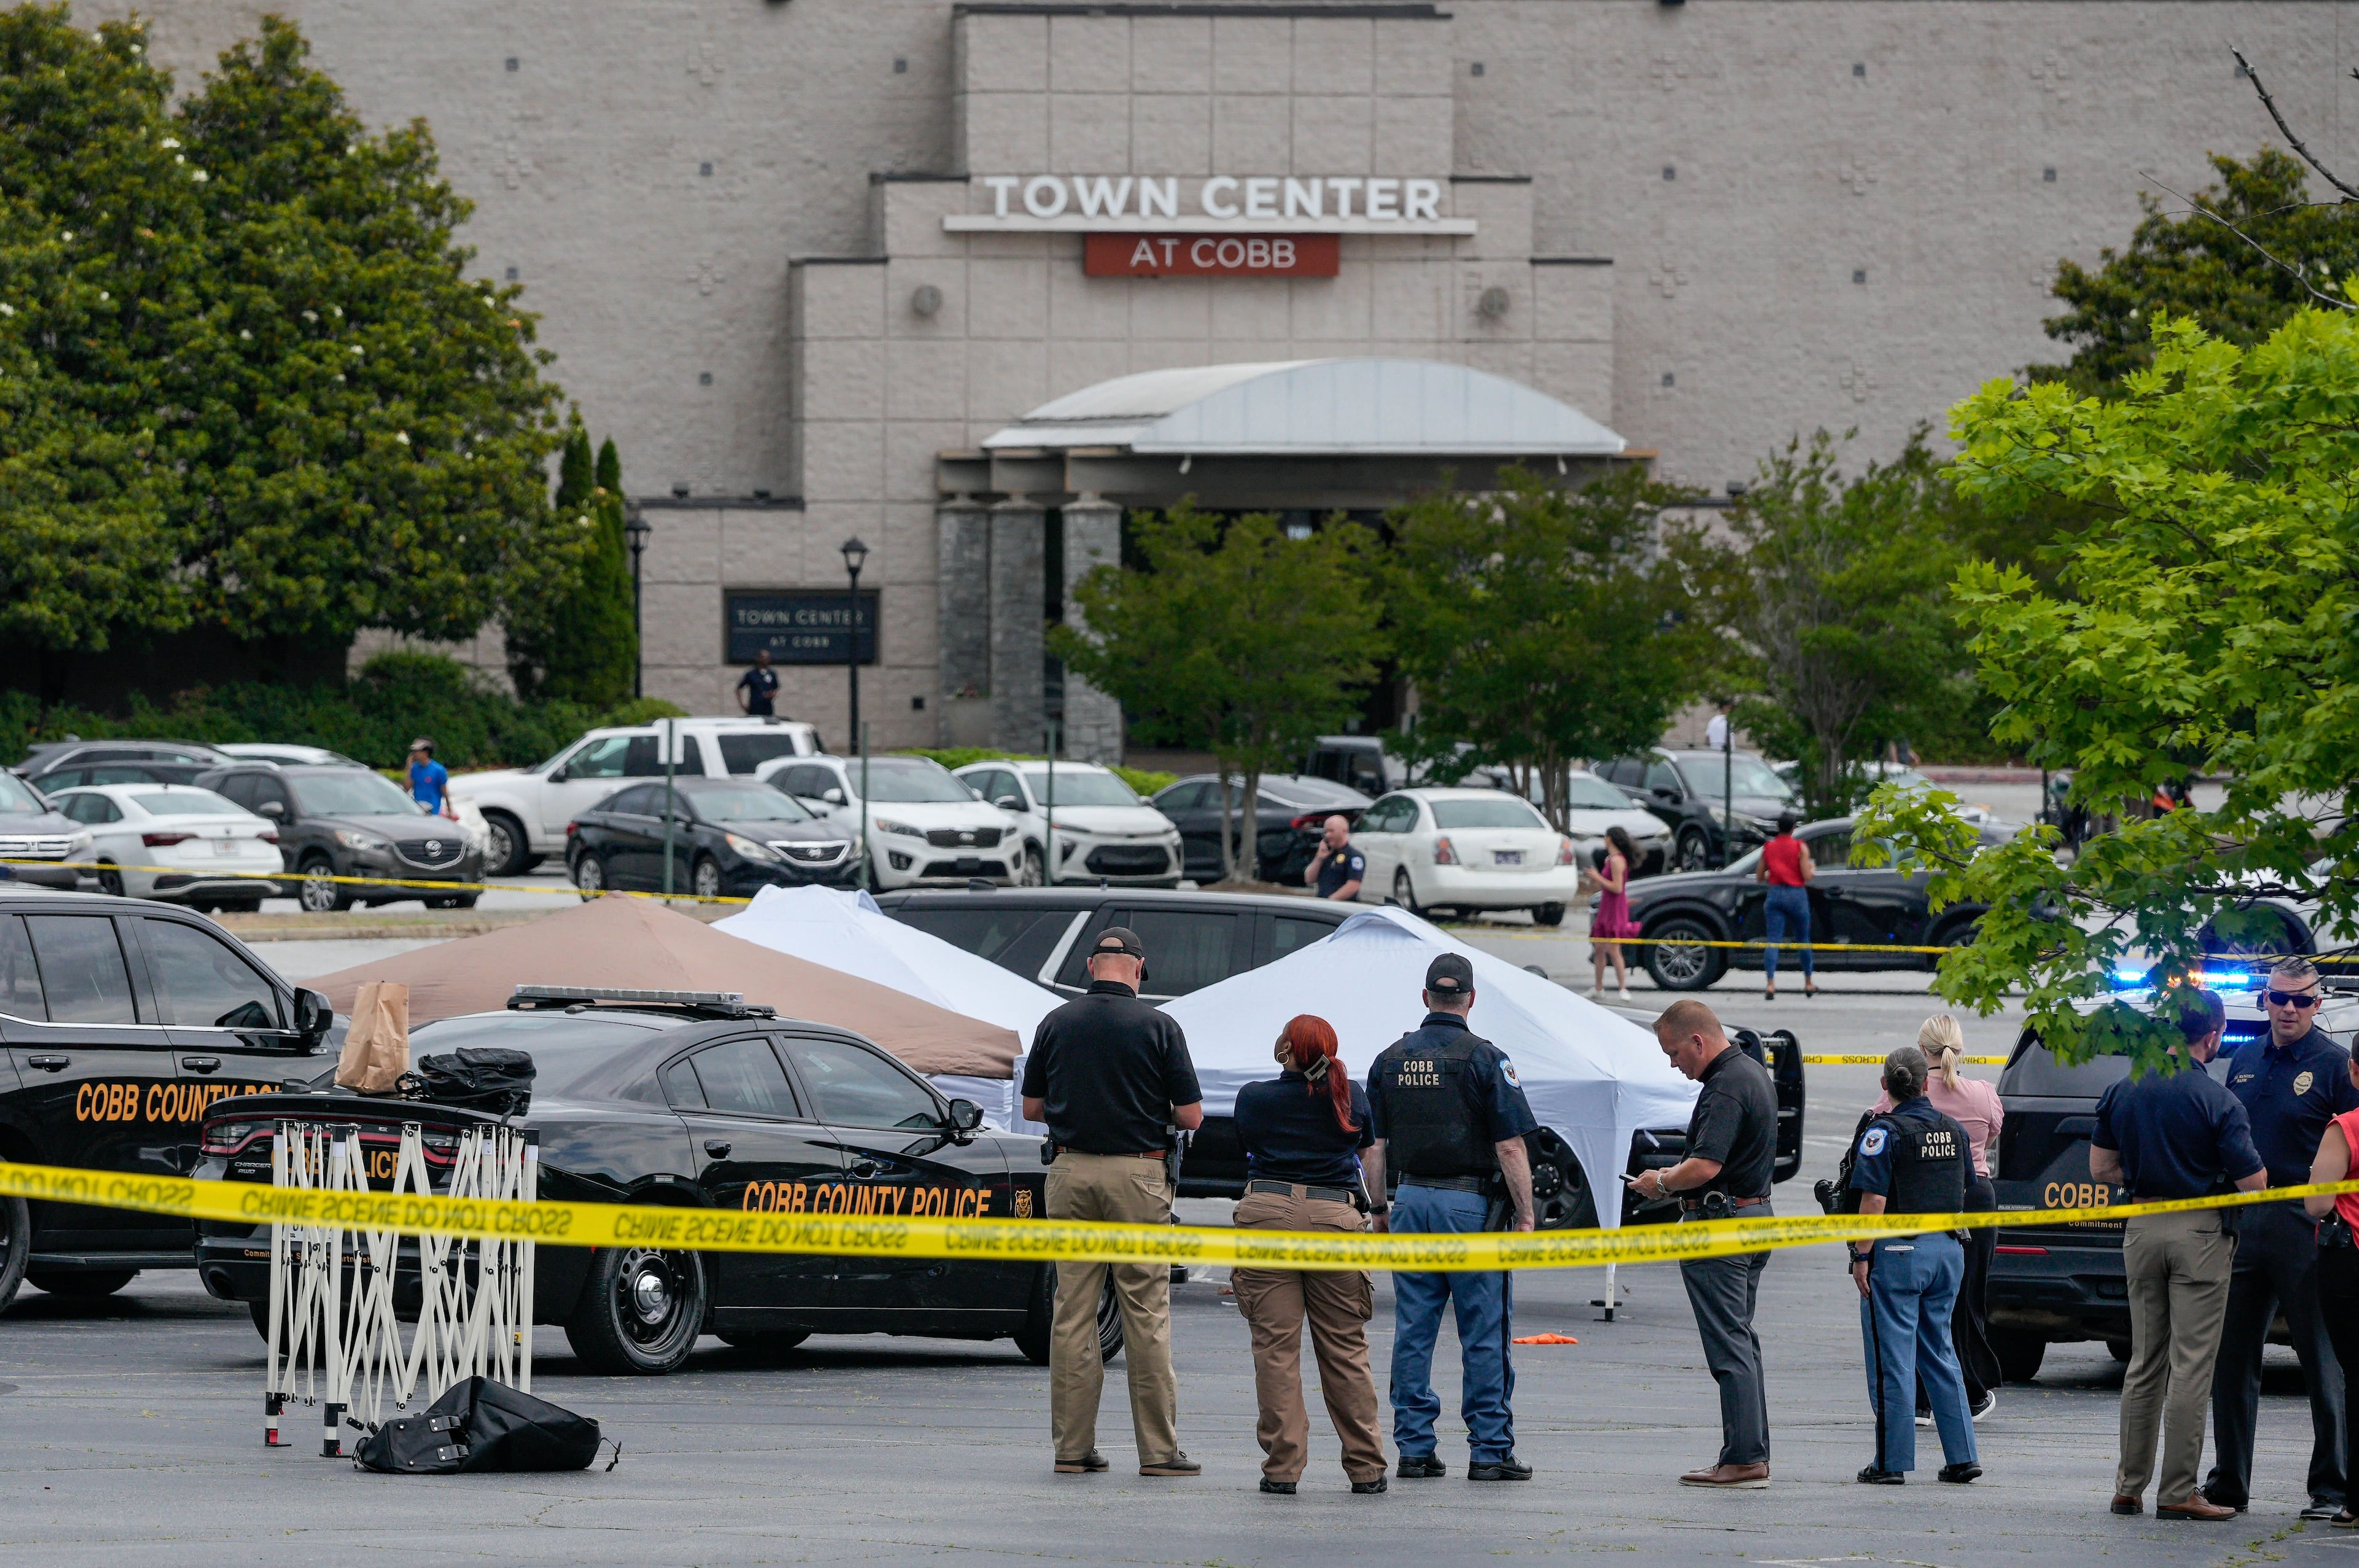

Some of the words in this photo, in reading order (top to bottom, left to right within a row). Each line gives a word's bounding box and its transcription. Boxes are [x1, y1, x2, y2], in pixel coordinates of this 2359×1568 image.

[984, 176, 1178, 219] TOWN
[1201, 177, 1442, 220] CENTER
[1130, 238, 1178, 268] AT
[1191, 238, 1296, 268] COBB
[737, 609, 790, 625] TOWN
[1404, 1061, 1434, 1072] COBB
[1842, 1055, 1877, 1064] CROSS
[1398, 1074, 1439, 1086] POLICE
[76, 1083, 139, 1121] COBB
[1926, 1132, 1952, 1144] COBB
[1922, 1144, 1955, 1158] POLICE
[743, 1181, 807, 1214] COBB
[814, 1184, 907, 1216] COUNTY
[911, 1187, 992, 1219] POLICE
[2044, 1182, 2109, 1208] COBB
